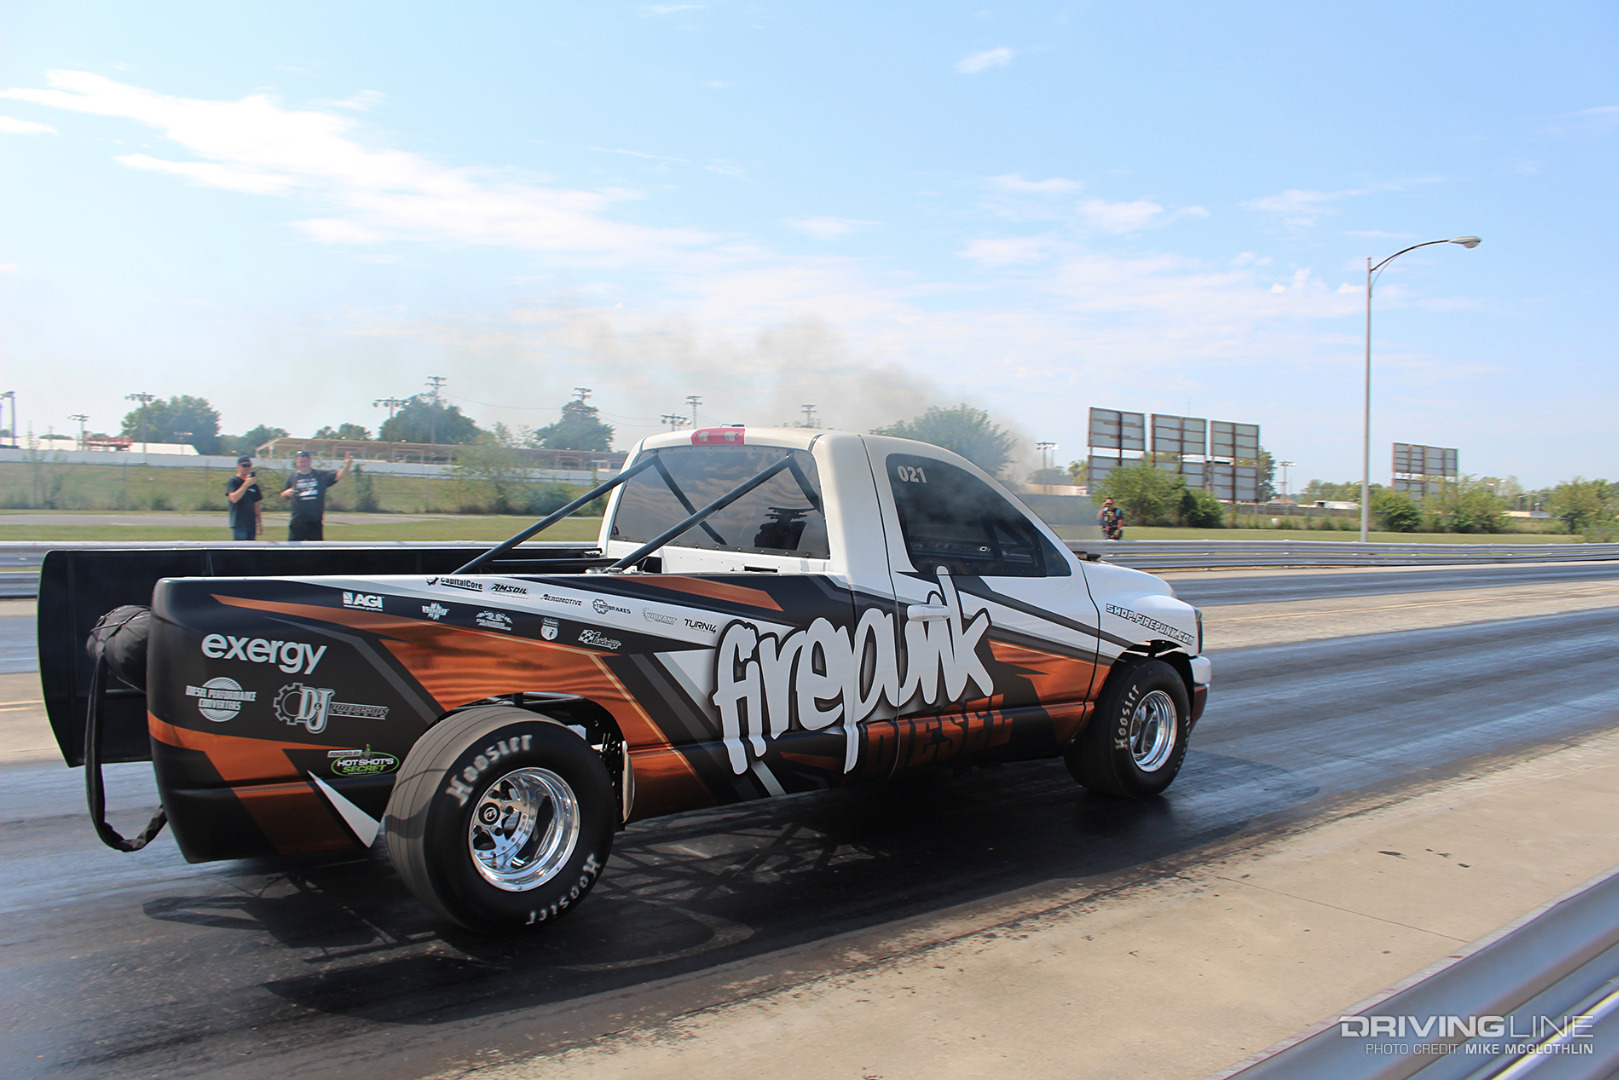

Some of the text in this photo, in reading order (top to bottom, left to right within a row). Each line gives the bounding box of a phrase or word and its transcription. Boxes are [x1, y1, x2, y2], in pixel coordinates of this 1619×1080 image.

[897, 465, 927, 483] 021
[441, 577, 483, 590] CapitalCore
[491, 583, 528, 595] AMSOIL
[353, 593, 383, 608] AGI
[684, 618, 718, 634] TURN14
[201, 633, 327, 674] exergy
[865, 694, 1014, 771] DIESEL
[337, 759, 359, 767] HOT
[342, 764, 387, 773] SECRET
